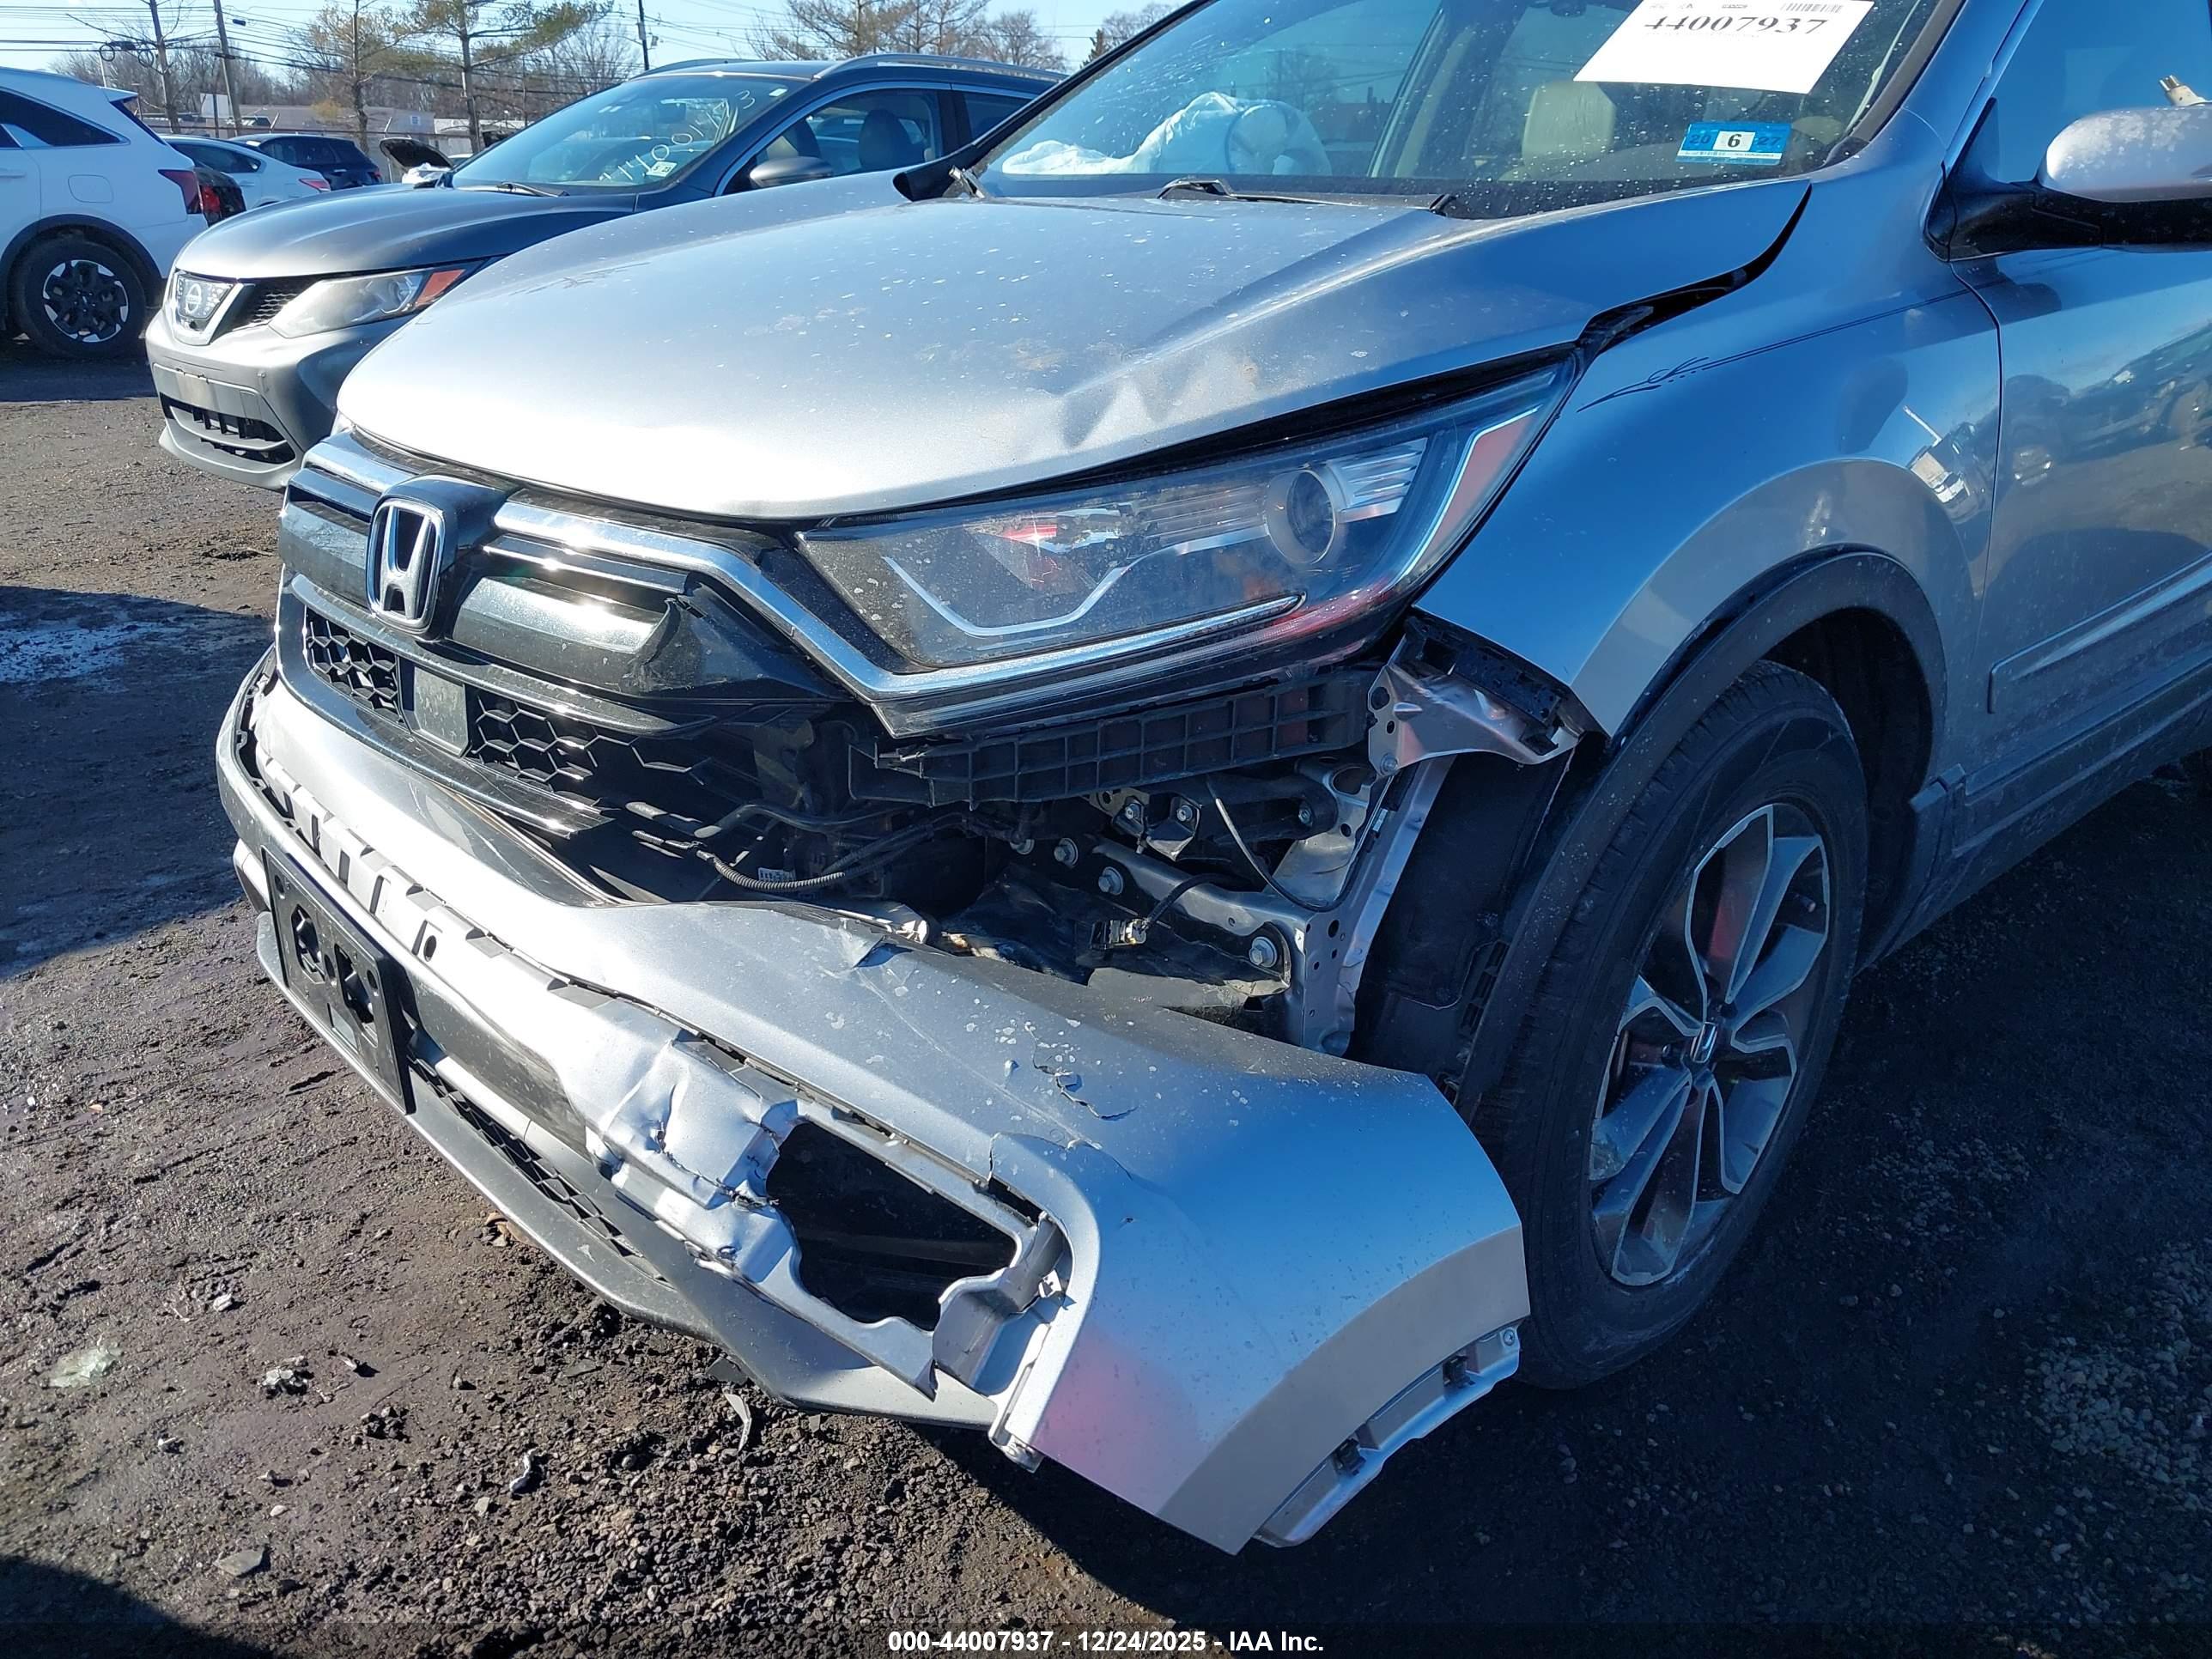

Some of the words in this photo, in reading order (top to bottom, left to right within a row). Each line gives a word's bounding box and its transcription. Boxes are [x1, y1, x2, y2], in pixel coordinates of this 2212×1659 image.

[1644, 15, 1828, 34] 44007937
[1689, 134, 1712, 145] 20
[1727, 133, 1742, 148] 6
